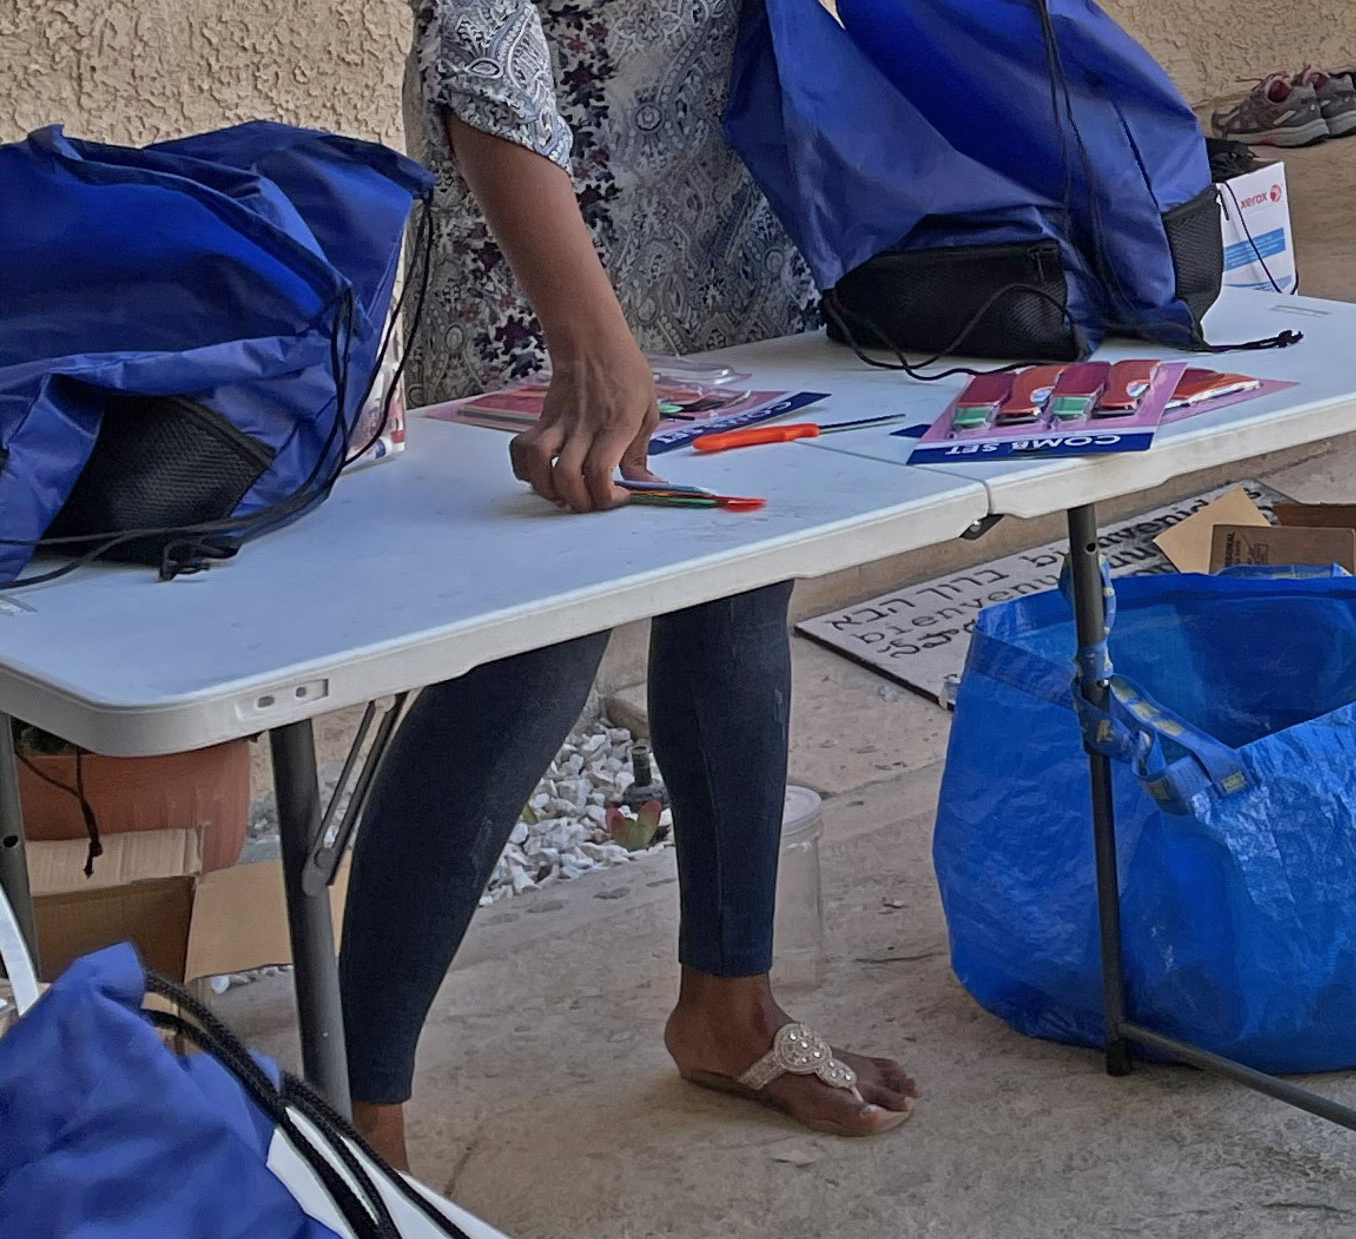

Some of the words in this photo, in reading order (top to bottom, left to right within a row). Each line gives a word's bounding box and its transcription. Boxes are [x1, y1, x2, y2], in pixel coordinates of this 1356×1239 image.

[1240, 191, 1268, 210] xerox
[944, 442, 1000, 456] SET
[1011, 434, 1122, 451] COMB
[916, 569, 1010, 601] ברוך
[831, 598, 916, 631] הבא
